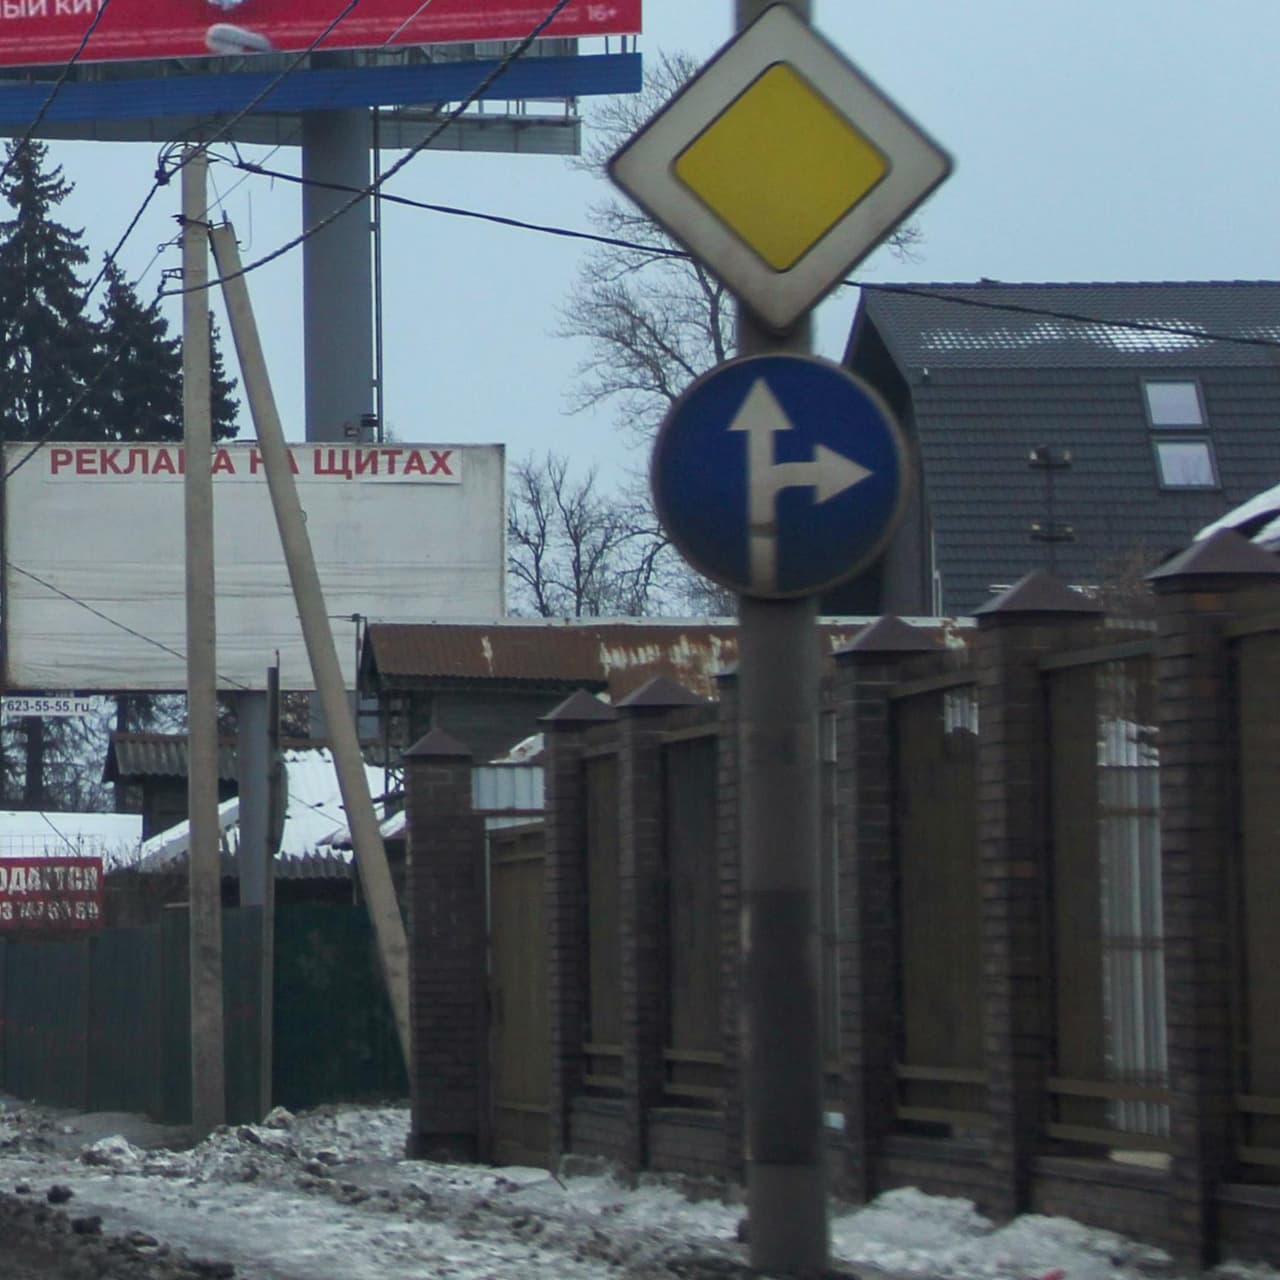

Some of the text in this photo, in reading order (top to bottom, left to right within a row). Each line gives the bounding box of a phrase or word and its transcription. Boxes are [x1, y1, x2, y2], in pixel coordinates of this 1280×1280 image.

[586, 4, 617, 21] 16+
[49, 448, 237, 475] РЕКЛАА
[313, 449, 454, 481] ЩИТАХ
